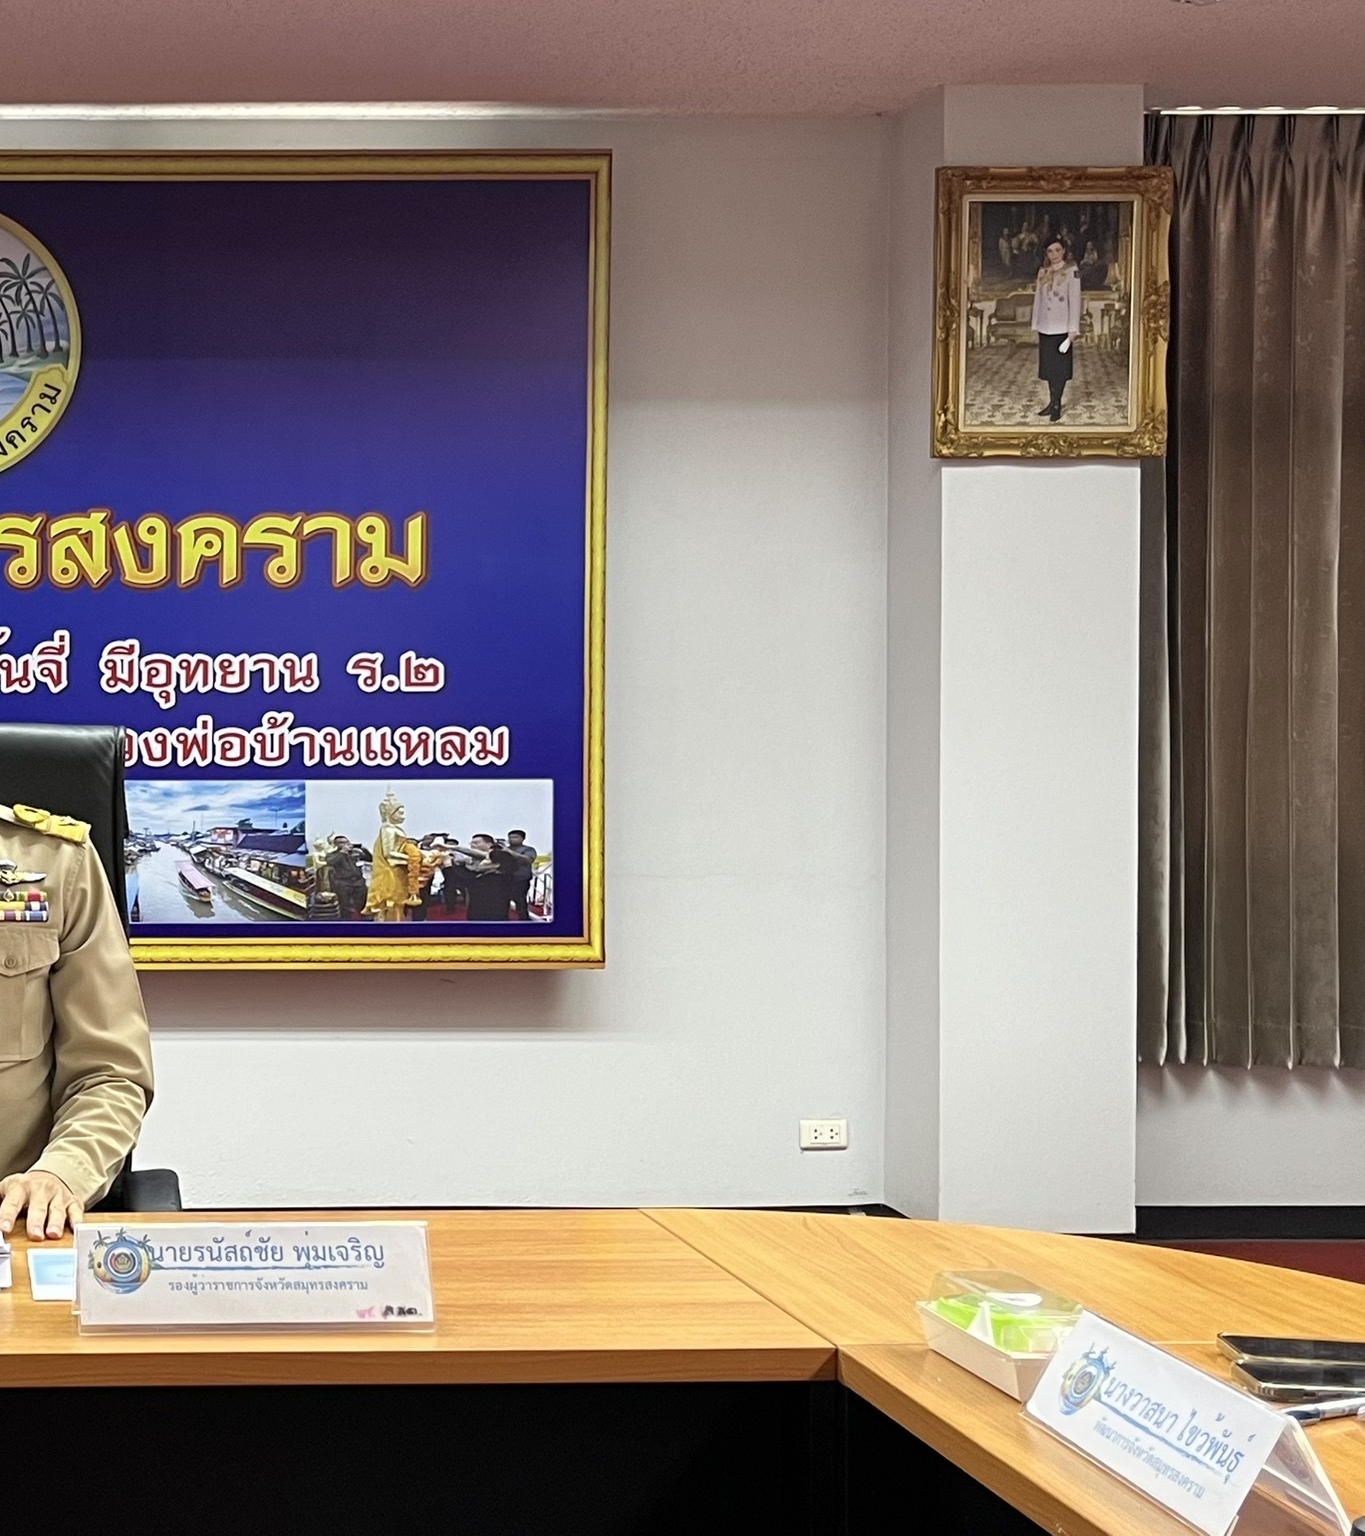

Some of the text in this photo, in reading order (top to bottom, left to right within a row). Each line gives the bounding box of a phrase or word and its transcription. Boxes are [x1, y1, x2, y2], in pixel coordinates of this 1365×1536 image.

[100, 640, 318, 708] มีอุทยาน
[347, 650, 445, 692] ร.๒
[293, 1230, 385, 1270] พุ่มเจริญ
[1103, 1377, 1179, 1434] นางวาสนา
